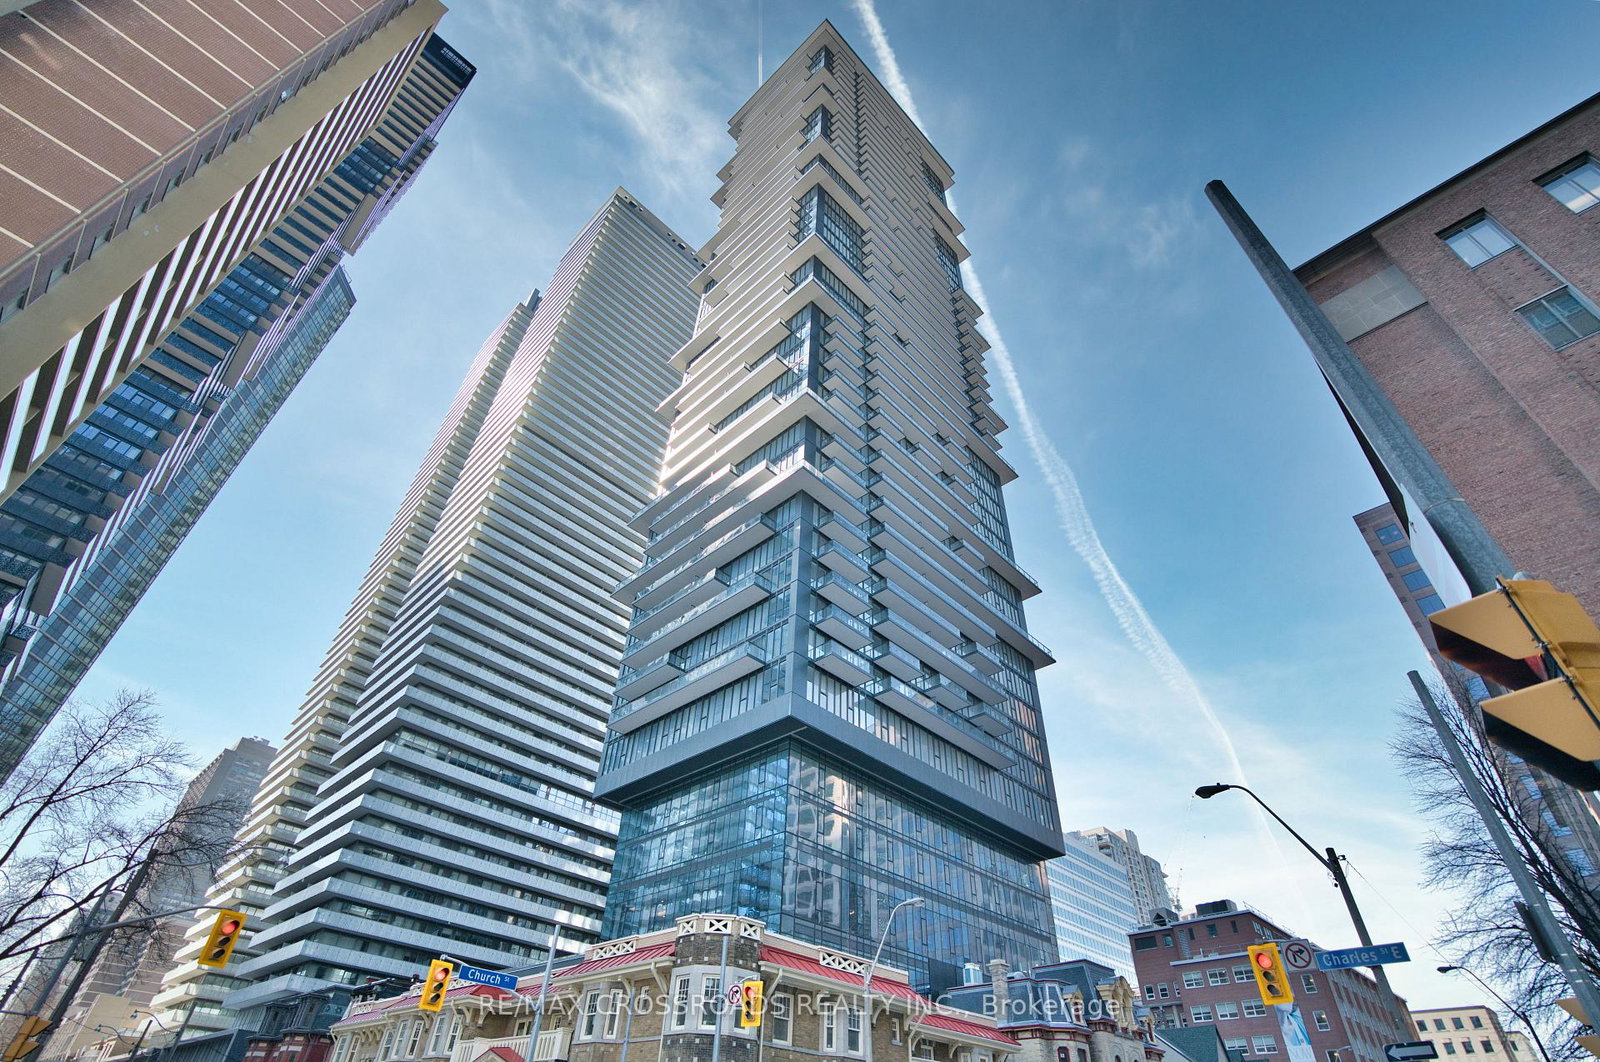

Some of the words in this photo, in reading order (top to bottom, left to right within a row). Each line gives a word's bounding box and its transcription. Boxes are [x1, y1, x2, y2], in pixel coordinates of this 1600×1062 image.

[1322, 950, 1378, 966] Charles
[1391, 945, 1402, 959] E
[468, 969, 501, 985] Church
